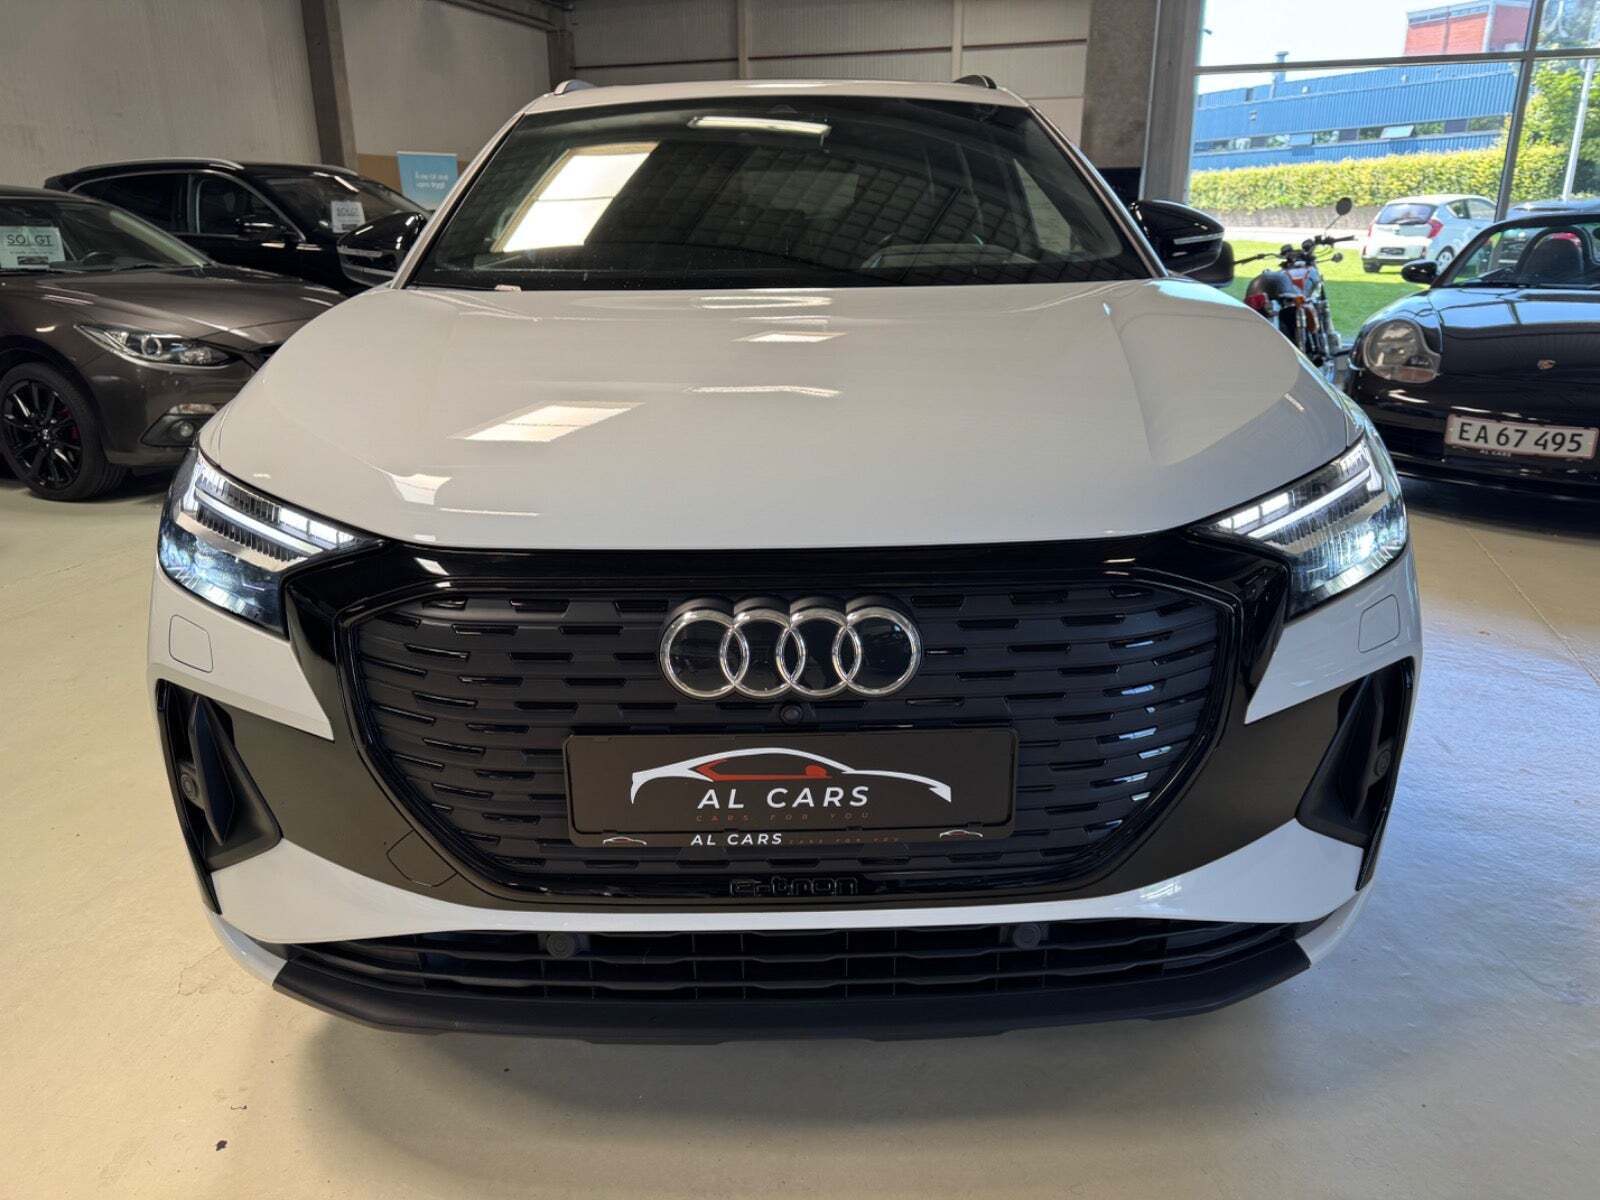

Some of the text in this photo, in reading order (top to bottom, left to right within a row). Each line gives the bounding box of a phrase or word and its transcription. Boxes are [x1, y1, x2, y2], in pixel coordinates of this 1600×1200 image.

[7, 233, 53, 247] SOLGT
[1458, 422, 1584, 453] EA 67 495
[697, 785, 870, 809] AL CARS
[696, 814, 750, 823] CARS
[830, 811, 868, 821] YOU
[690, 833, 717, 846] AL
[727, 832, 783, 846] CARS
[729, 875, 859, 897] e-tron
